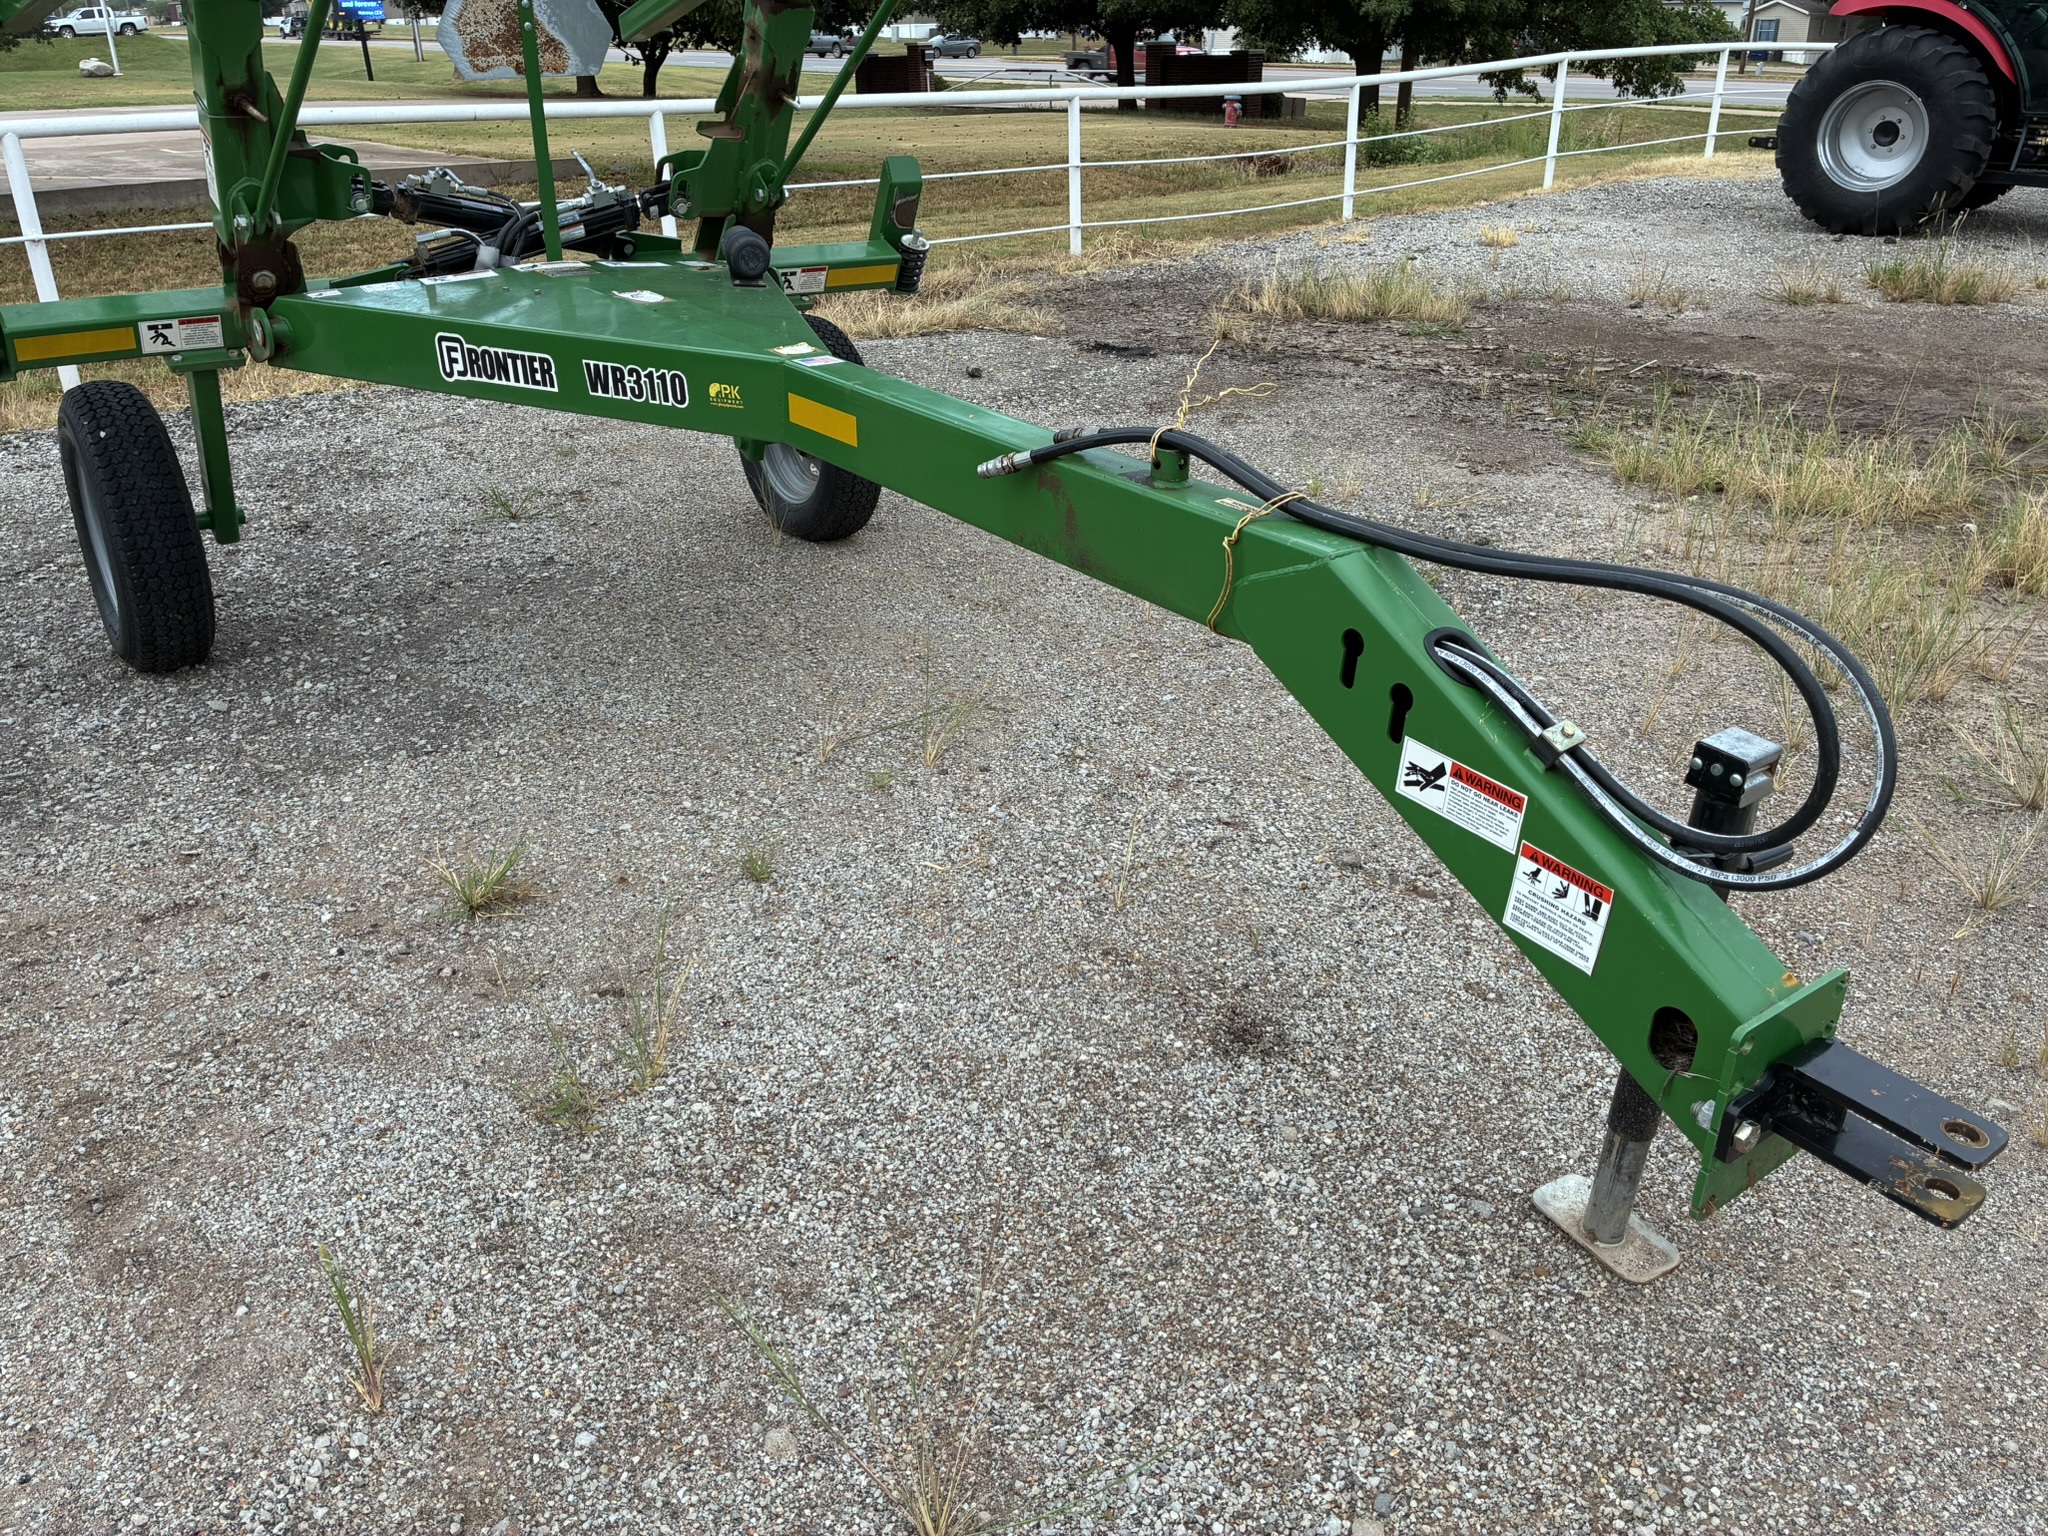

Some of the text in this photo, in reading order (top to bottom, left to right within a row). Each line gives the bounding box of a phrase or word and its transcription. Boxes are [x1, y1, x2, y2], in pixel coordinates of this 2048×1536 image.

[437, 334, 557, 390] FRONTIER
[585, 361, 688, 407] WR3110
[1443, 651, 1459, 662] MPa
[1450, 779, 1518, 818] DO NOT GO NEAR LEAKS
[1464, 771, 1522, 809] WARNING
[1540, 855, 1604, 899] WARNING
[1697, 866, 1707, 874] 21
[1709, 869, 1729, 879] MPa
[1731, 874, 1755, 882] (3000
[1527, 889, 1586, 927] CRUSHING HAZARD
